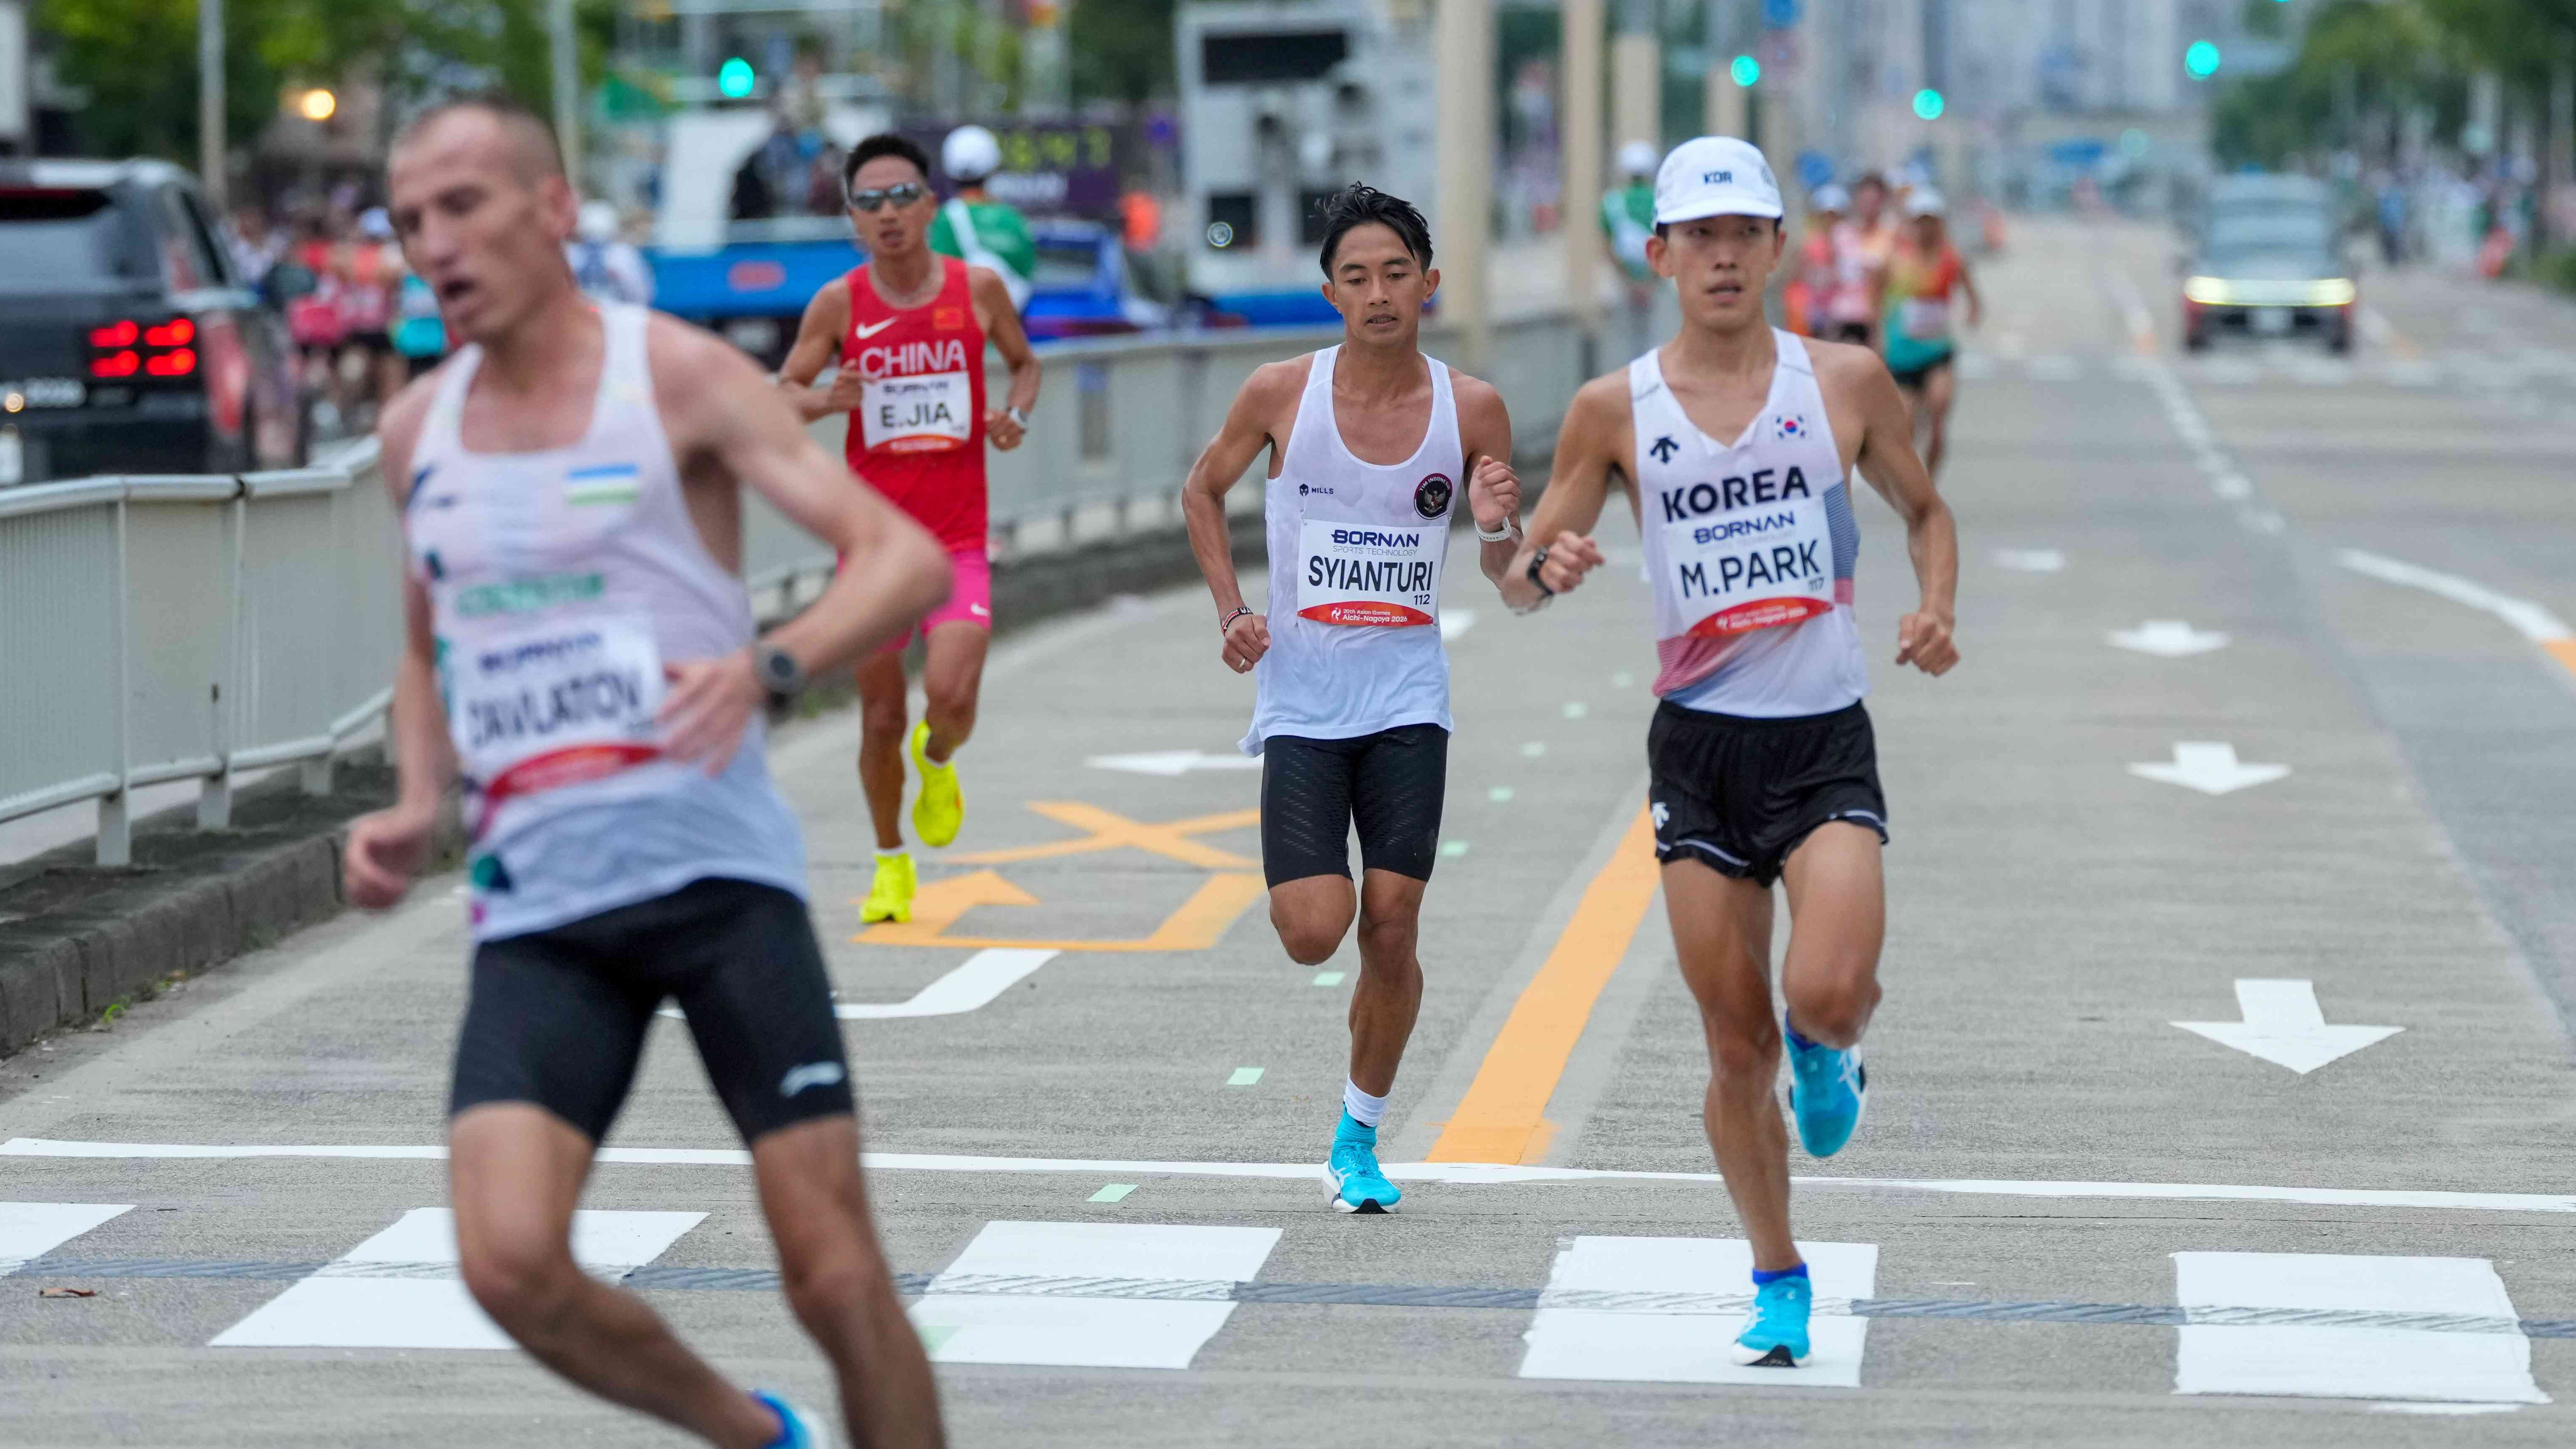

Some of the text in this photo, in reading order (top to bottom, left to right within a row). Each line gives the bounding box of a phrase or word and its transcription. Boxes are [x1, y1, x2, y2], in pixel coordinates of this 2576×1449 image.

[1704, 171, 1732, 184] KOR
[860, 338, 967, 378] CHINA
[881, 402, 952, 428] E.JIA
[1419, 476, 1451, 491] TIM INDONESIA
[1662, 465, 1810, 523] KOREA
[1694, 510, 1795, 544] BORNAN
[1331, 530, 1419, 548] BORNAN
[1333, 545, 1418, 556] SPORTS TECHNOLOGY
[1308, 556, 1433, 592] SYIANTURI
[1680, 539, 1820, 599] M.PARK
[1414, 594, 1430, 605] 112
[1343, 614, 1390, 623] Aichi-Nagoya
